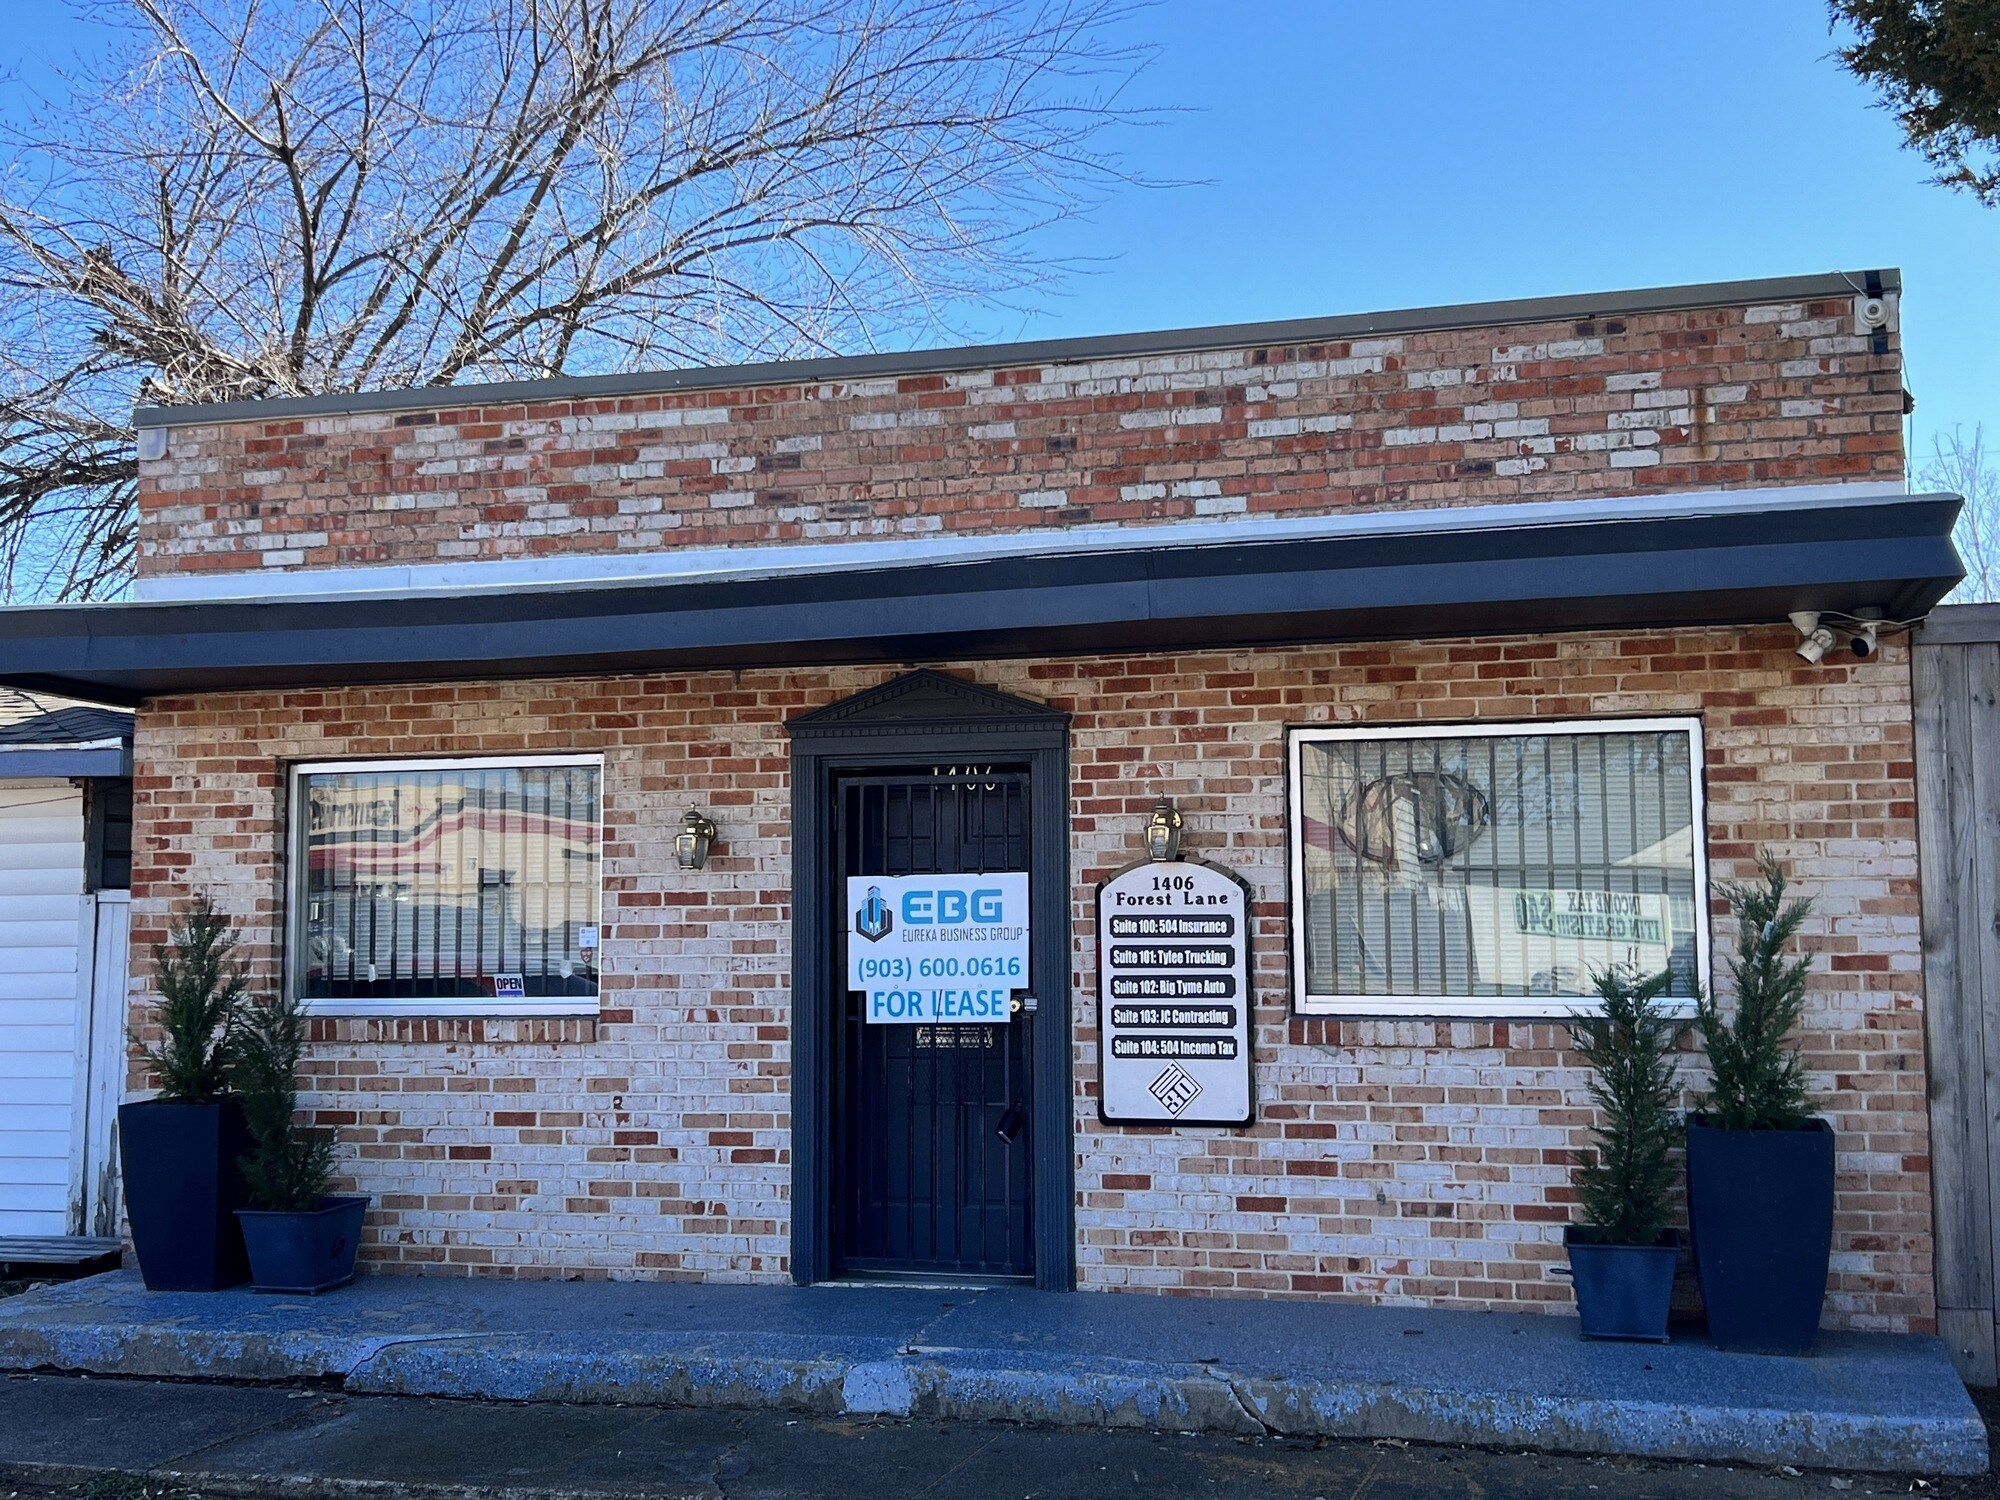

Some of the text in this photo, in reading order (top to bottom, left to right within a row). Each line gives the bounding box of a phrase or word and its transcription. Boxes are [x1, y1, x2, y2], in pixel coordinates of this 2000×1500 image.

[1152, 876, 1194, 891] 1406
[902, 889, 1003, 924] EBG
[1116, 891, 1229, 906] Forest Lane
[902, 926, 1023, 943] EUREKA BUSINESS GROUP
[1113, 919, 1227, 934] Suite 100: 504 Insurance
[1113, 949, 1138, 964] Suite
[1138, 949, 1157, 964] 101:
[1184, 950, 1227, 966] Trucking
[858, 956, 1021, 982] (903) 600.0616
[496, 977, 523, 990] OPEN
[1114, 980, 1226, 996] Suite 102: Big Tyme Auto
[873, 989, 1004, 1018] FOR LEASE
[1114, 1009, 1229, 1025] Suite 103: JC Contracting
[1114, 1040, 1235, 1056] Suite 104: 504 Income Tax
